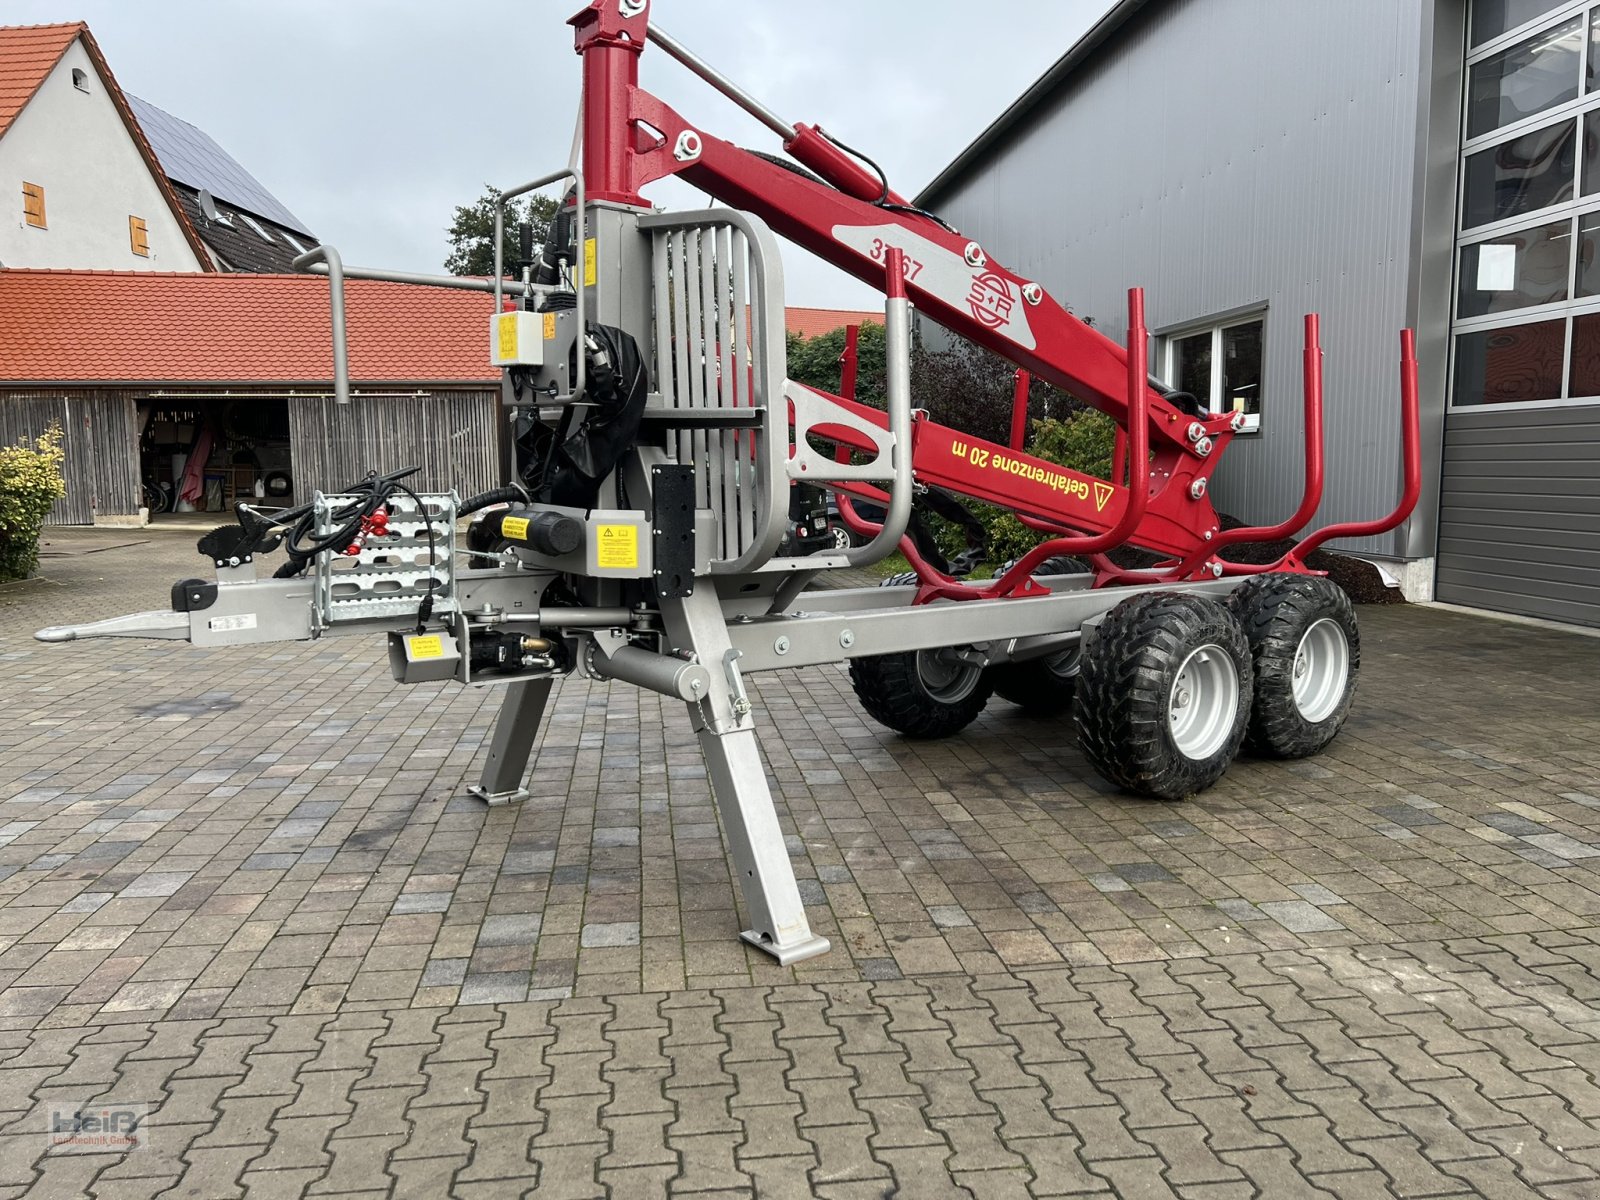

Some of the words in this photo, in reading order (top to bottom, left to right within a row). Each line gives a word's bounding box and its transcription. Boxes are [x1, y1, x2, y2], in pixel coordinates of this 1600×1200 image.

[952, 440, 967, 457] m
[970, 447, 989, 468] 20
[992, 454, 1089, 500] Gefahrenzone
